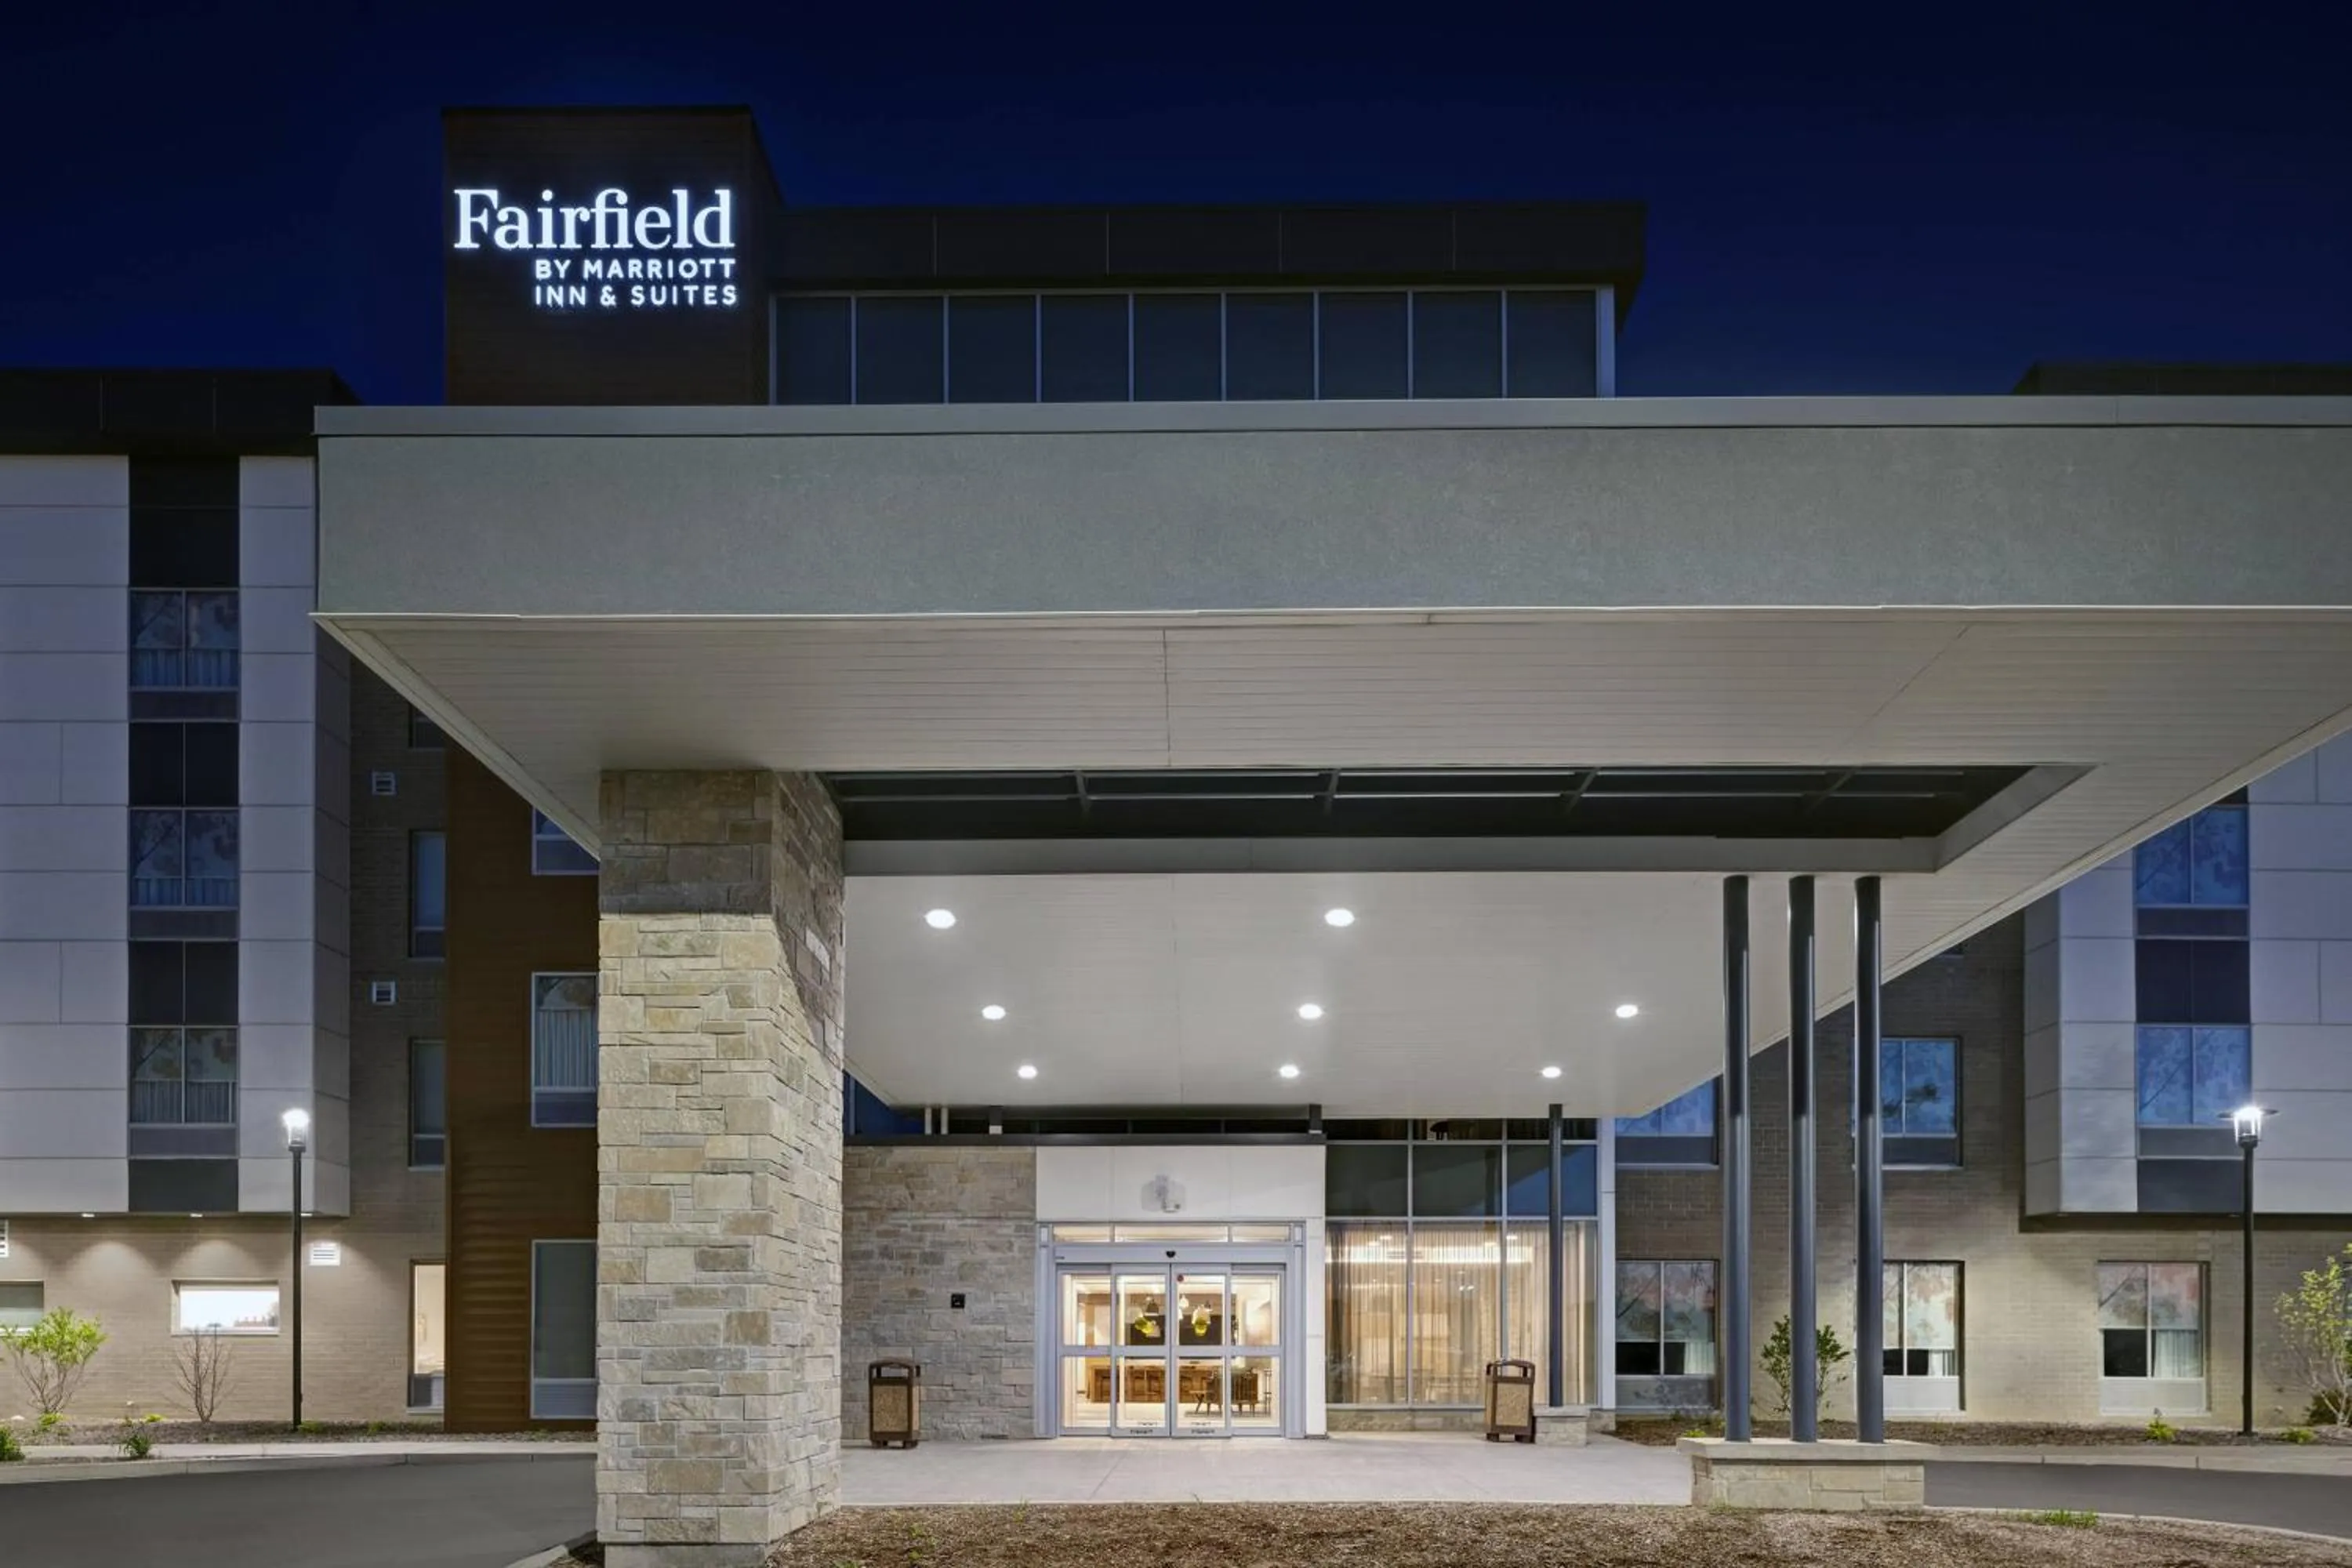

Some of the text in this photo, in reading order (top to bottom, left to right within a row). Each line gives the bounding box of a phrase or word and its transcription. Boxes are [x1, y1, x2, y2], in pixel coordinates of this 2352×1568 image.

[453, 187, 736, 250] Fairfield
[535, 257, 736, 280] BY MARRIOTT
[535, 284, 737, 307] INN & SUITES
